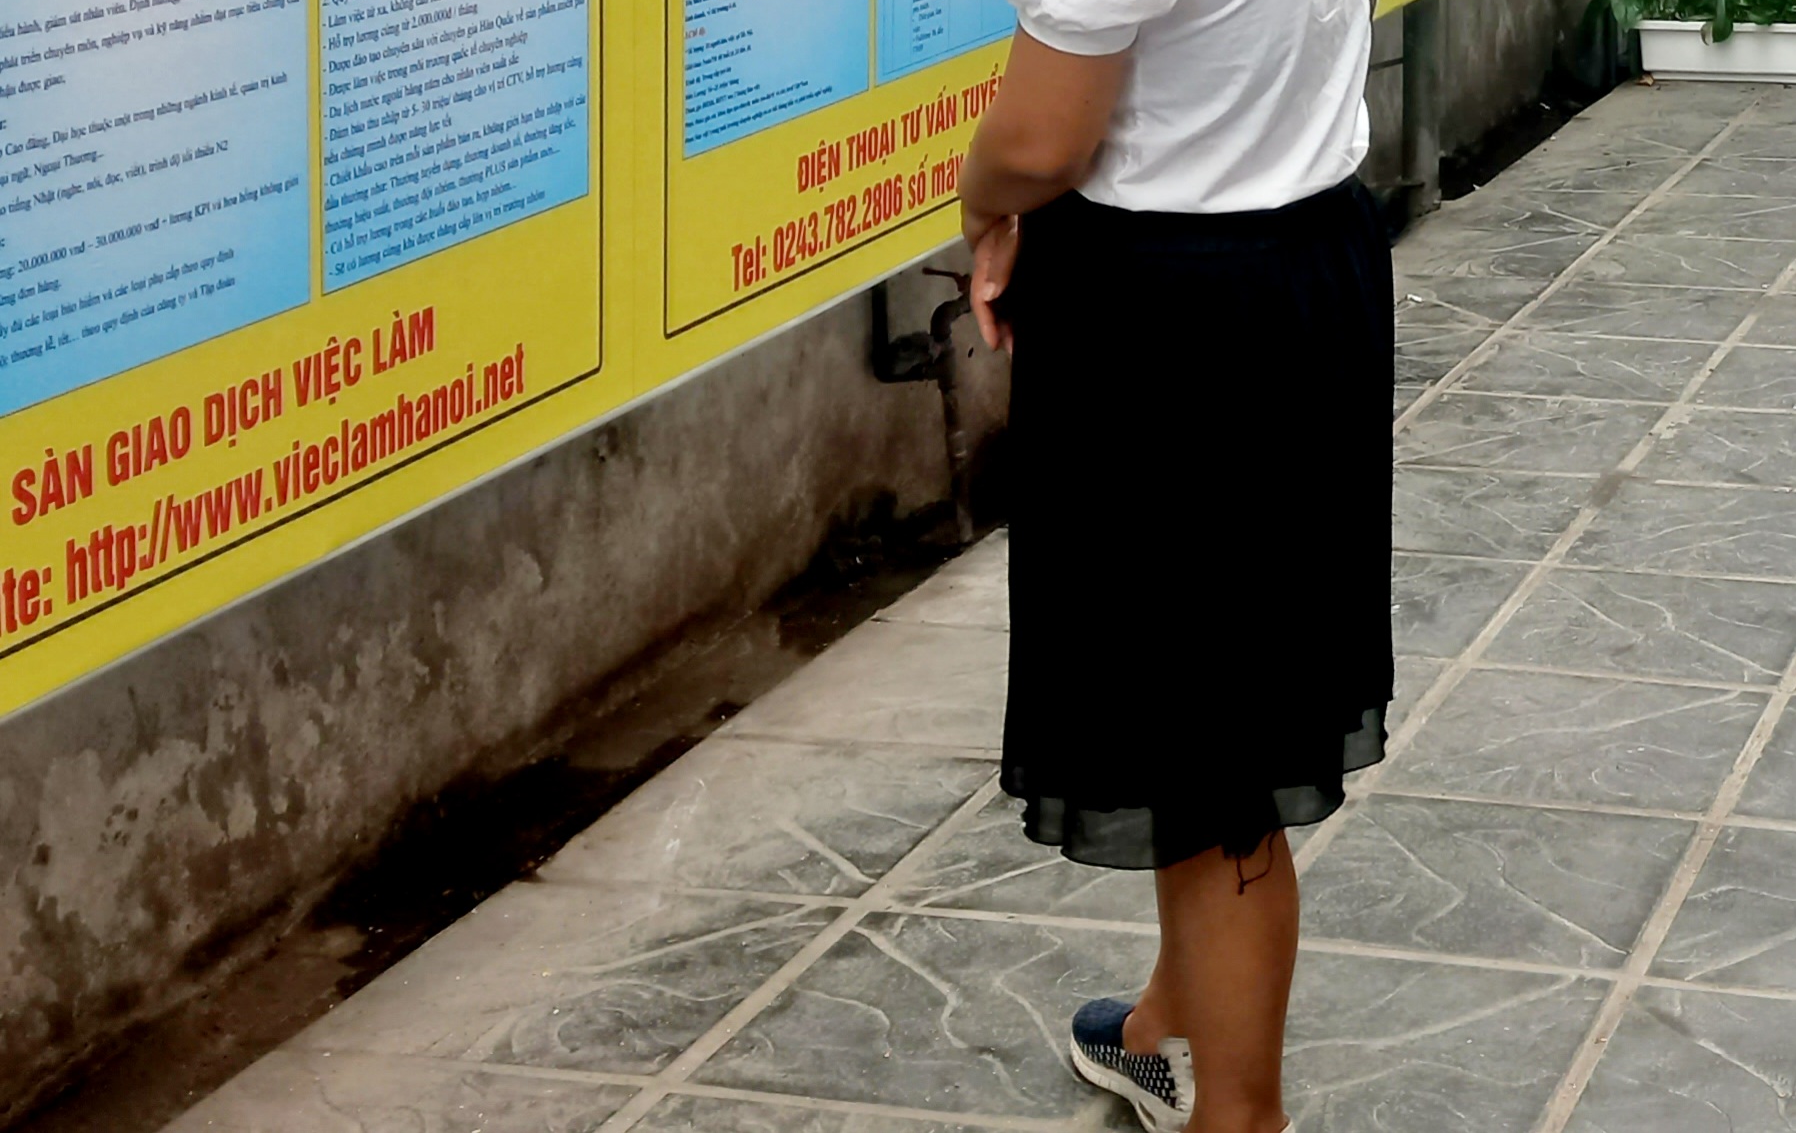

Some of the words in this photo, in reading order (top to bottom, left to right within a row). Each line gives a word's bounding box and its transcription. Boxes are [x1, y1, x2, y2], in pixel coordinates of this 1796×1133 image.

[732, 235, 767, 292] Tel:
[773, 173, 903, 274] 0243.782.2806
[907, 153, 929, 211] số
[797, 139, 841, 194] ĐIỆN
[847, 119, 896, 172] THOẠI
[901, 103, 924, 148] TƯ
[926, 84, 957, 139] VẤN
[0, 566, 53, 636] te:
[66, 342, 524, 605] http://www.vieclamhanoi.net
[11, 444, 93, 527] SÀN
[106, 406, 191, 487] GIAO
[203, 368, 282, 448] DỊCH
[292, 336, 362, 408] VIỆC
[372, 306, 435, 376] LÀM
